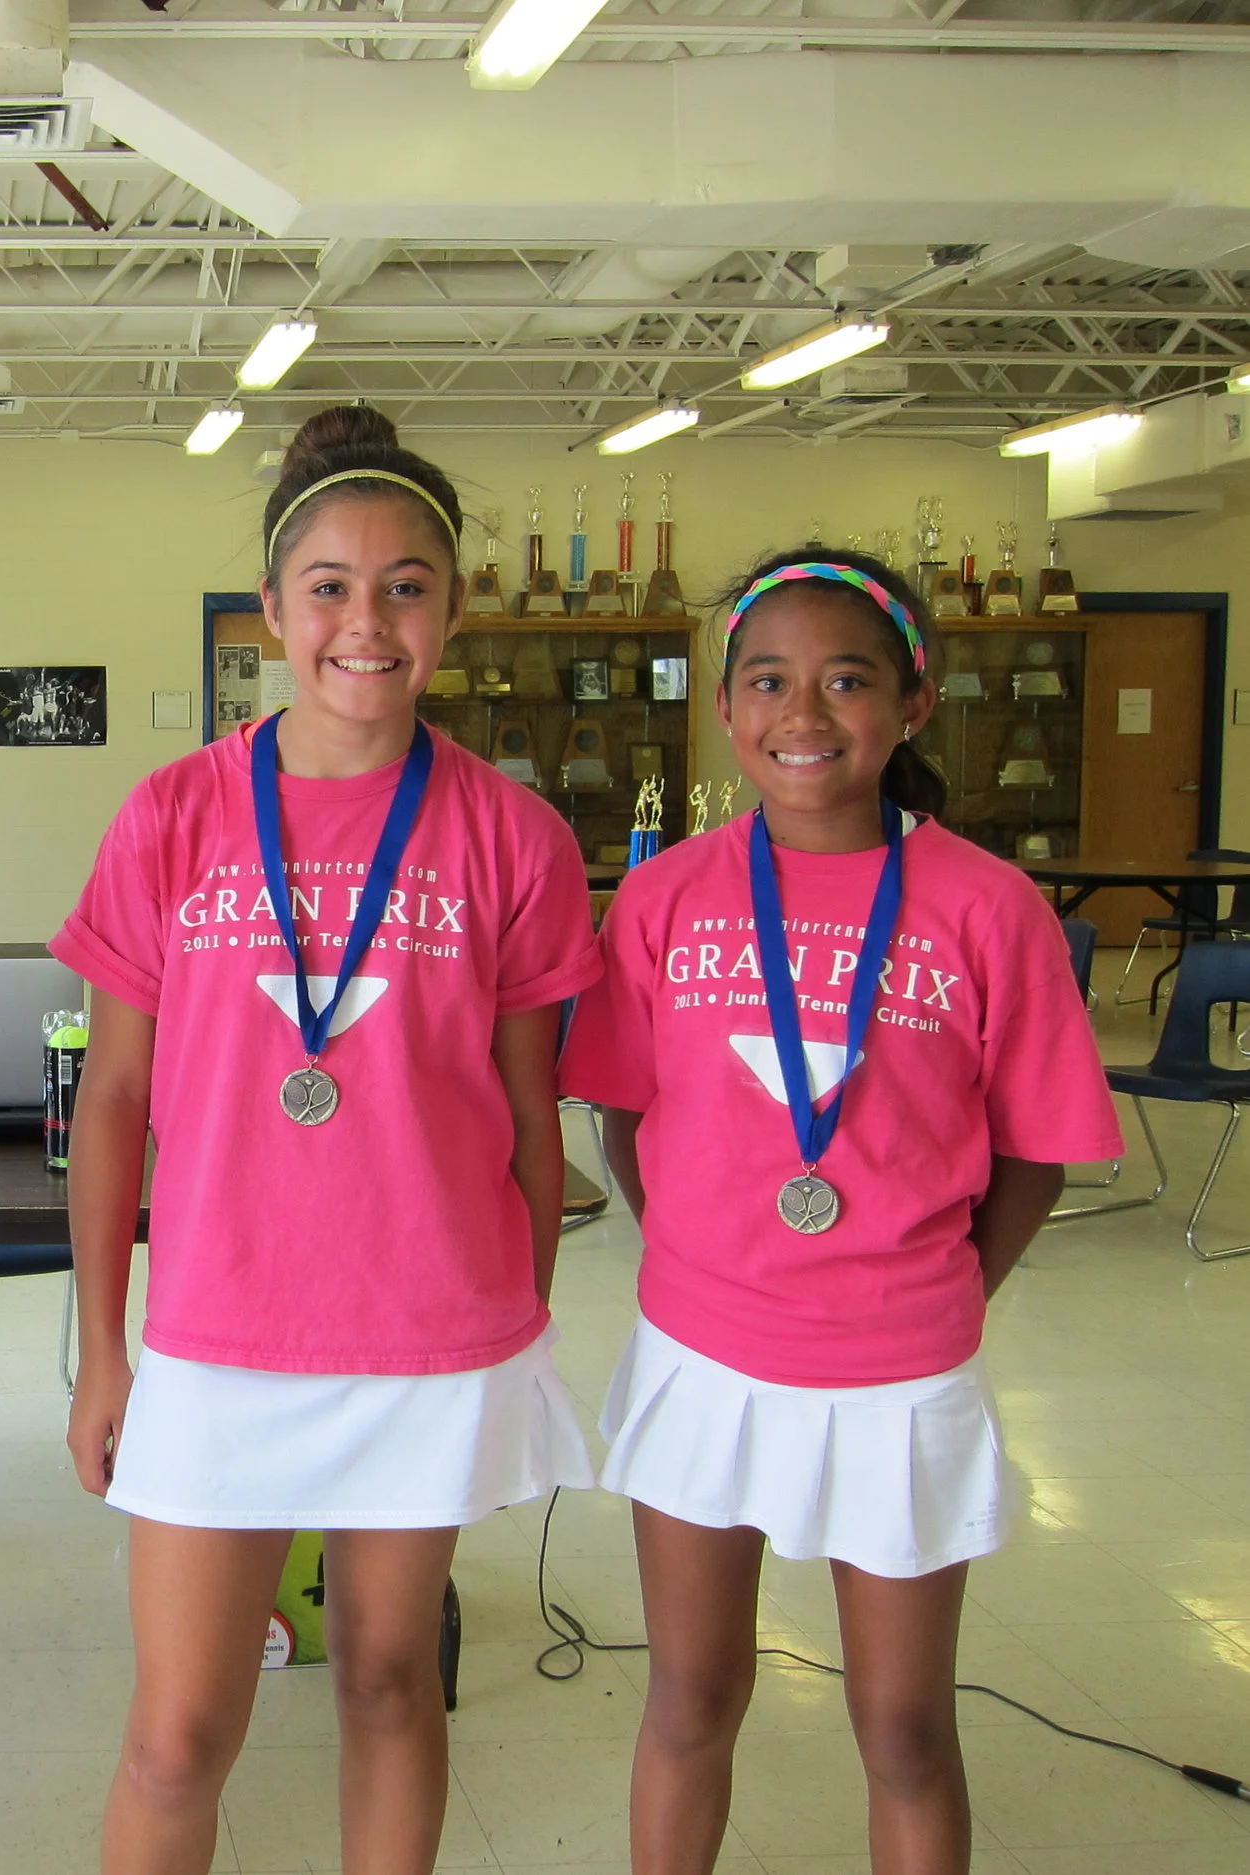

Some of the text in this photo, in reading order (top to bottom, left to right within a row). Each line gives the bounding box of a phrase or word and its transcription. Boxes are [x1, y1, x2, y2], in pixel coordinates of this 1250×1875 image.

[179, 885, 466, 933] GRAN PRIX
[182, 932, 460, 959] 2011 Junr Teis Circuit
[667, 943, 959, 1012] GRAN PRIX
[674, 989, 942, 1034] 2011 Juni Tenn Circuit
